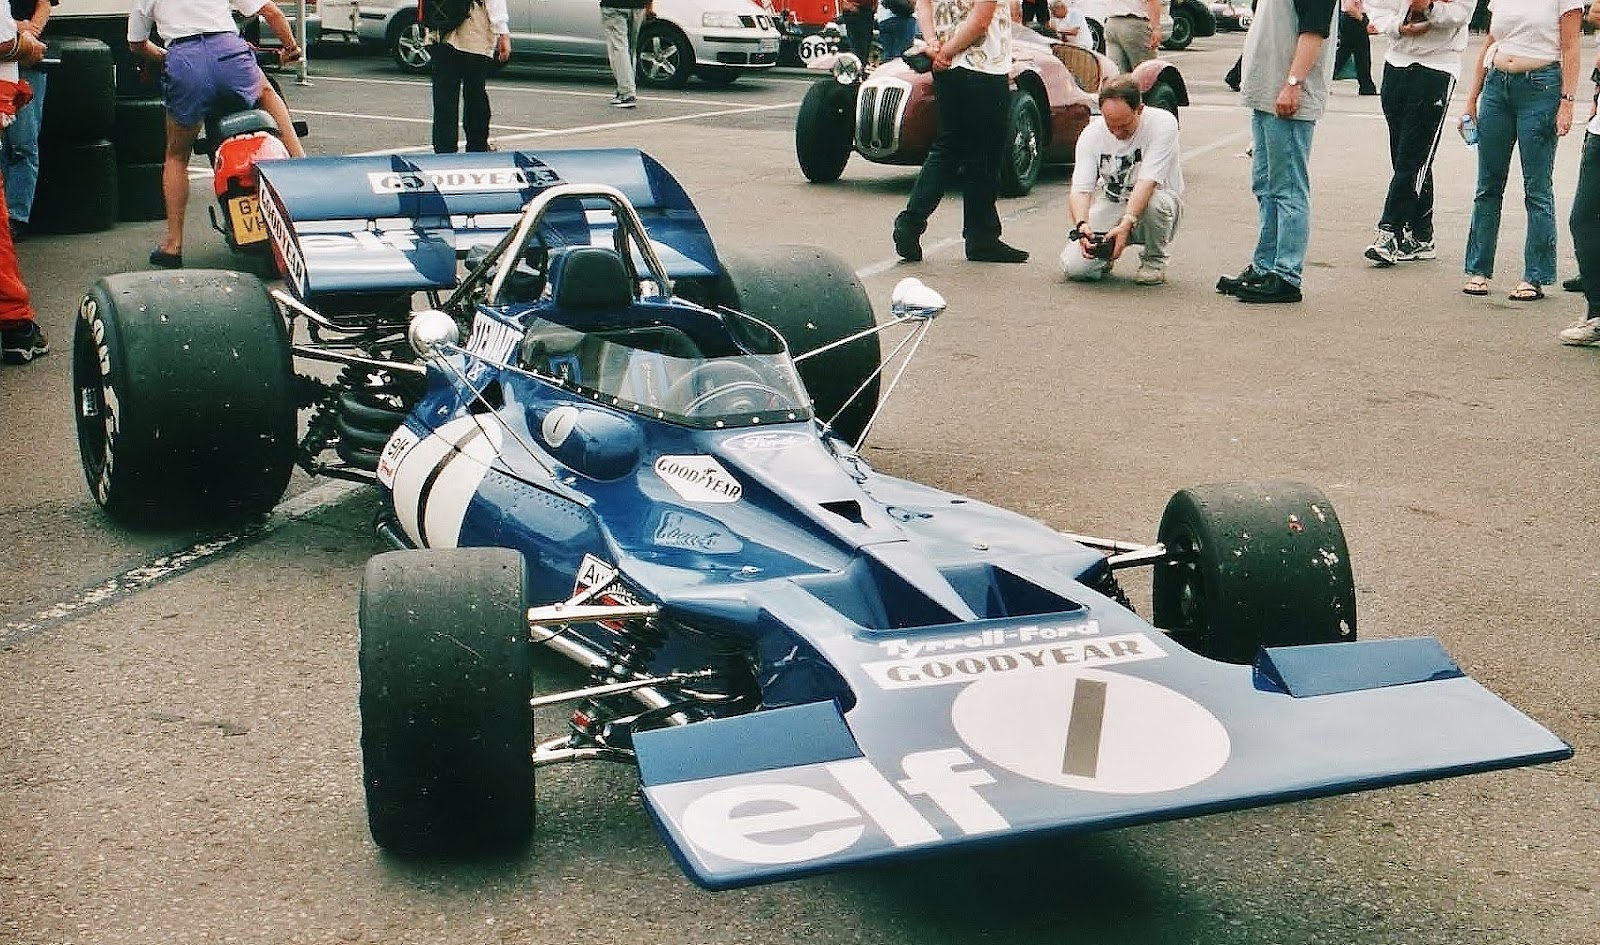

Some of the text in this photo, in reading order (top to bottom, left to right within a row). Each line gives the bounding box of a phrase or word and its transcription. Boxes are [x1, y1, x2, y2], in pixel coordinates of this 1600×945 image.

[657, 458, 741, 498] GOODYEAR
[879, 620, 1099, 658] Tyrrell-Ford
[887, 640, 1142, 682] GOODYEAR
[1062, 678, 1108, 778] 1
[682, 748, 1011, 864] elf
